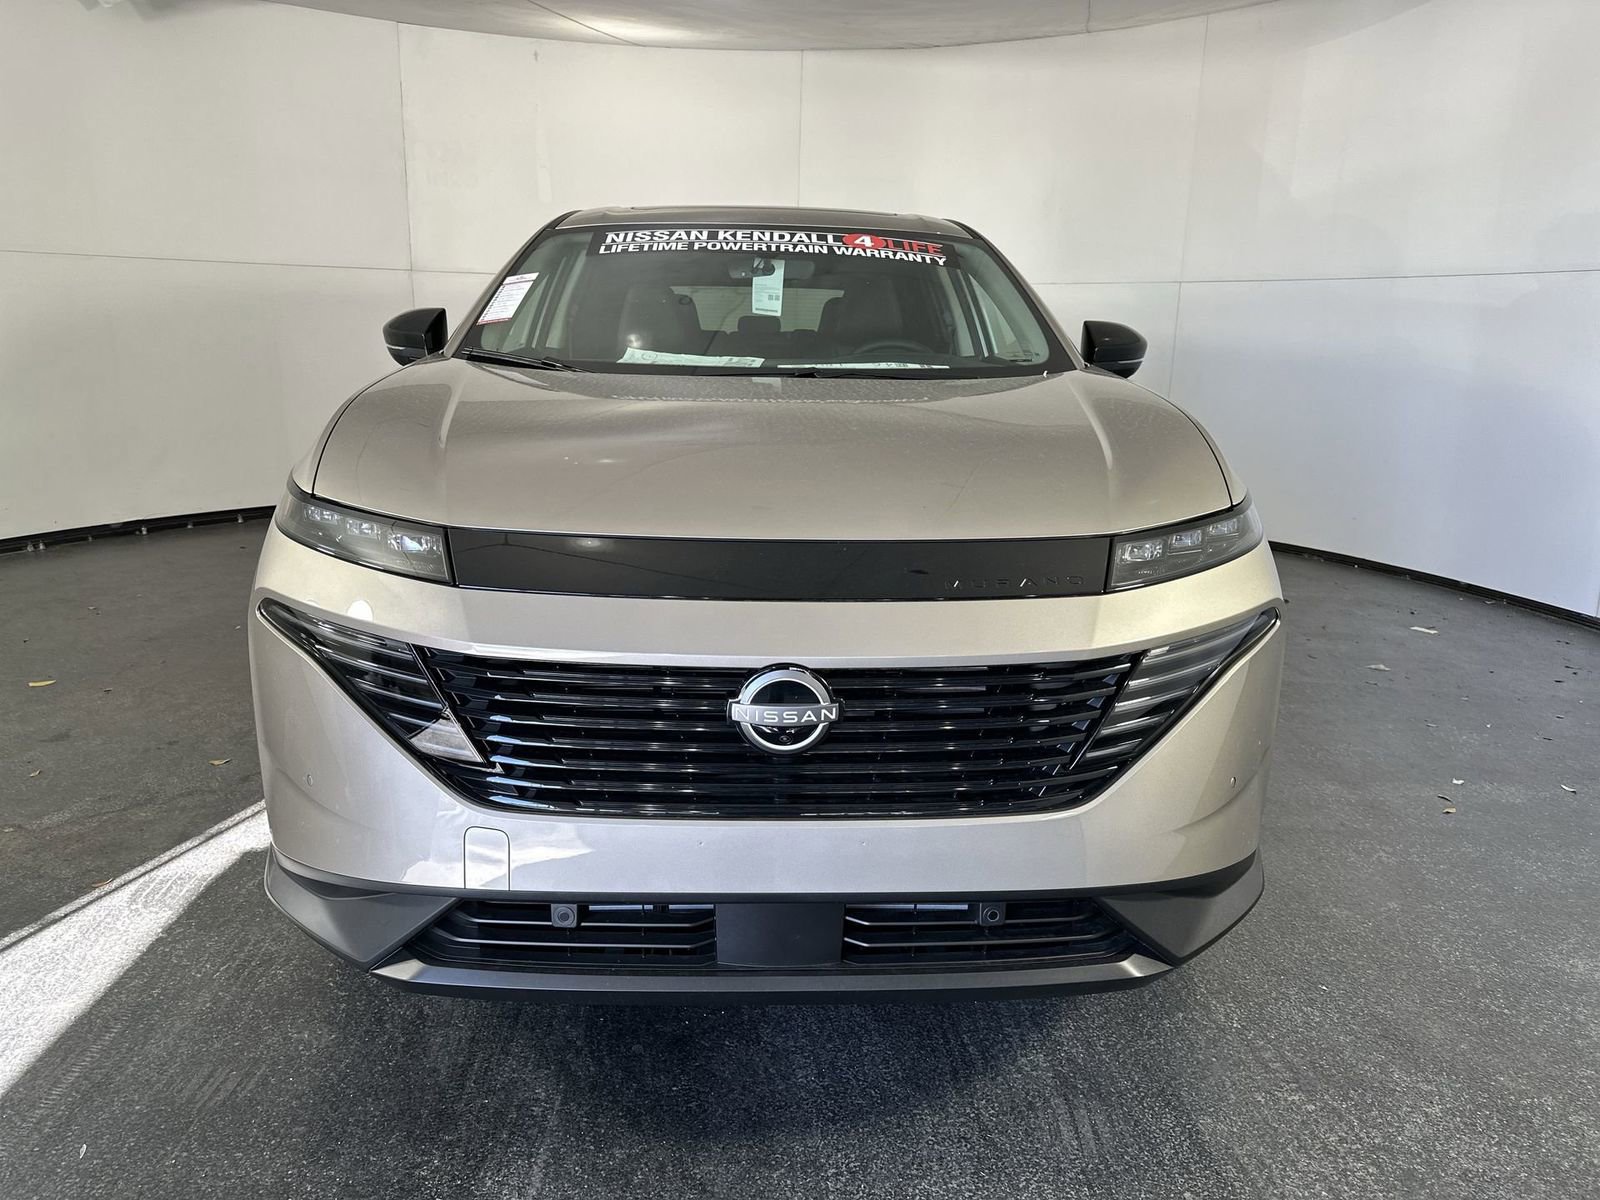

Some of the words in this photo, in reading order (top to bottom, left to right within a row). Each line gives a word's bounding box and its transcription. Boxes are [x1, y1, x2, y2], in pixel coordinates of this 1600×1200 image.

[599, 241, 689, 254] LIFETIME
[693, 241, 828, 254] POWERTRAIN
[833, 246, 946, 266] WARRANTY
[605, 230, 708, 244] NISSAN
[718, 230, 843, 245] KENDALL
[854, 236, 874, 247] 4
[887, 240, 943, 255] LIFE
[735, 707, 836, 723] NISSAN
